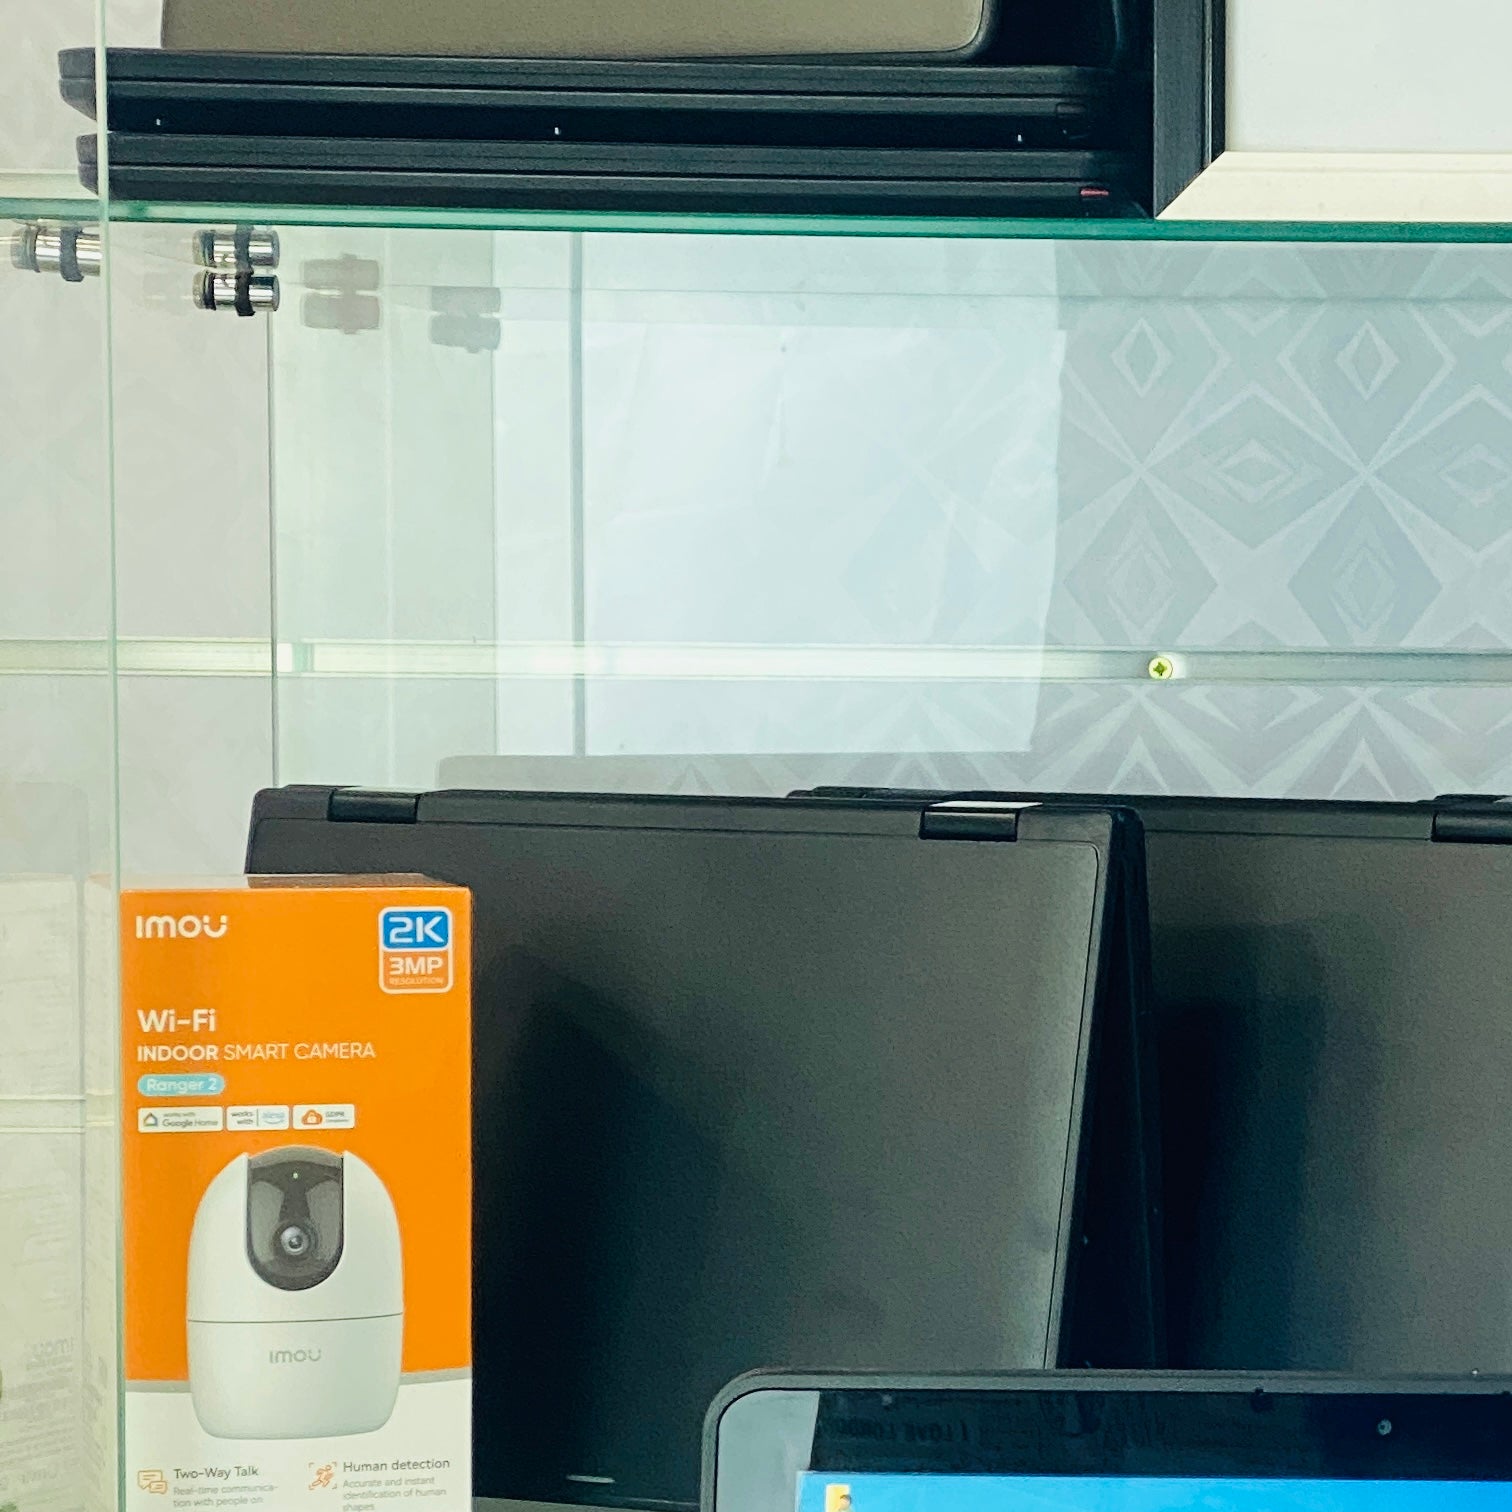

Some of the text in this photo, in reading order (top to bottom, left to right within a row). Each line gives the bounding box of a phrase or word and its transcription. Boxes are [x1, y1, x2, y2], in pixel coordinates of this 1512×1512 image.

[388, 915, 445, 944] 2K
[388, 955, 443, 975] 3MP
[137, 1008, 217, 1033] Wi-Fi
[137, 1042, 376, 1062] INDOOR SMART CAMERA
[146, 1078, 217, 1094] Ranger 2
[162, 1118, 219, 1129] Google Home
[173, 1465, 259, 1480] Two-Way Talk
[343, 1458, 450, 1473] Human detection
[385, 1477, 402, 1486] and
